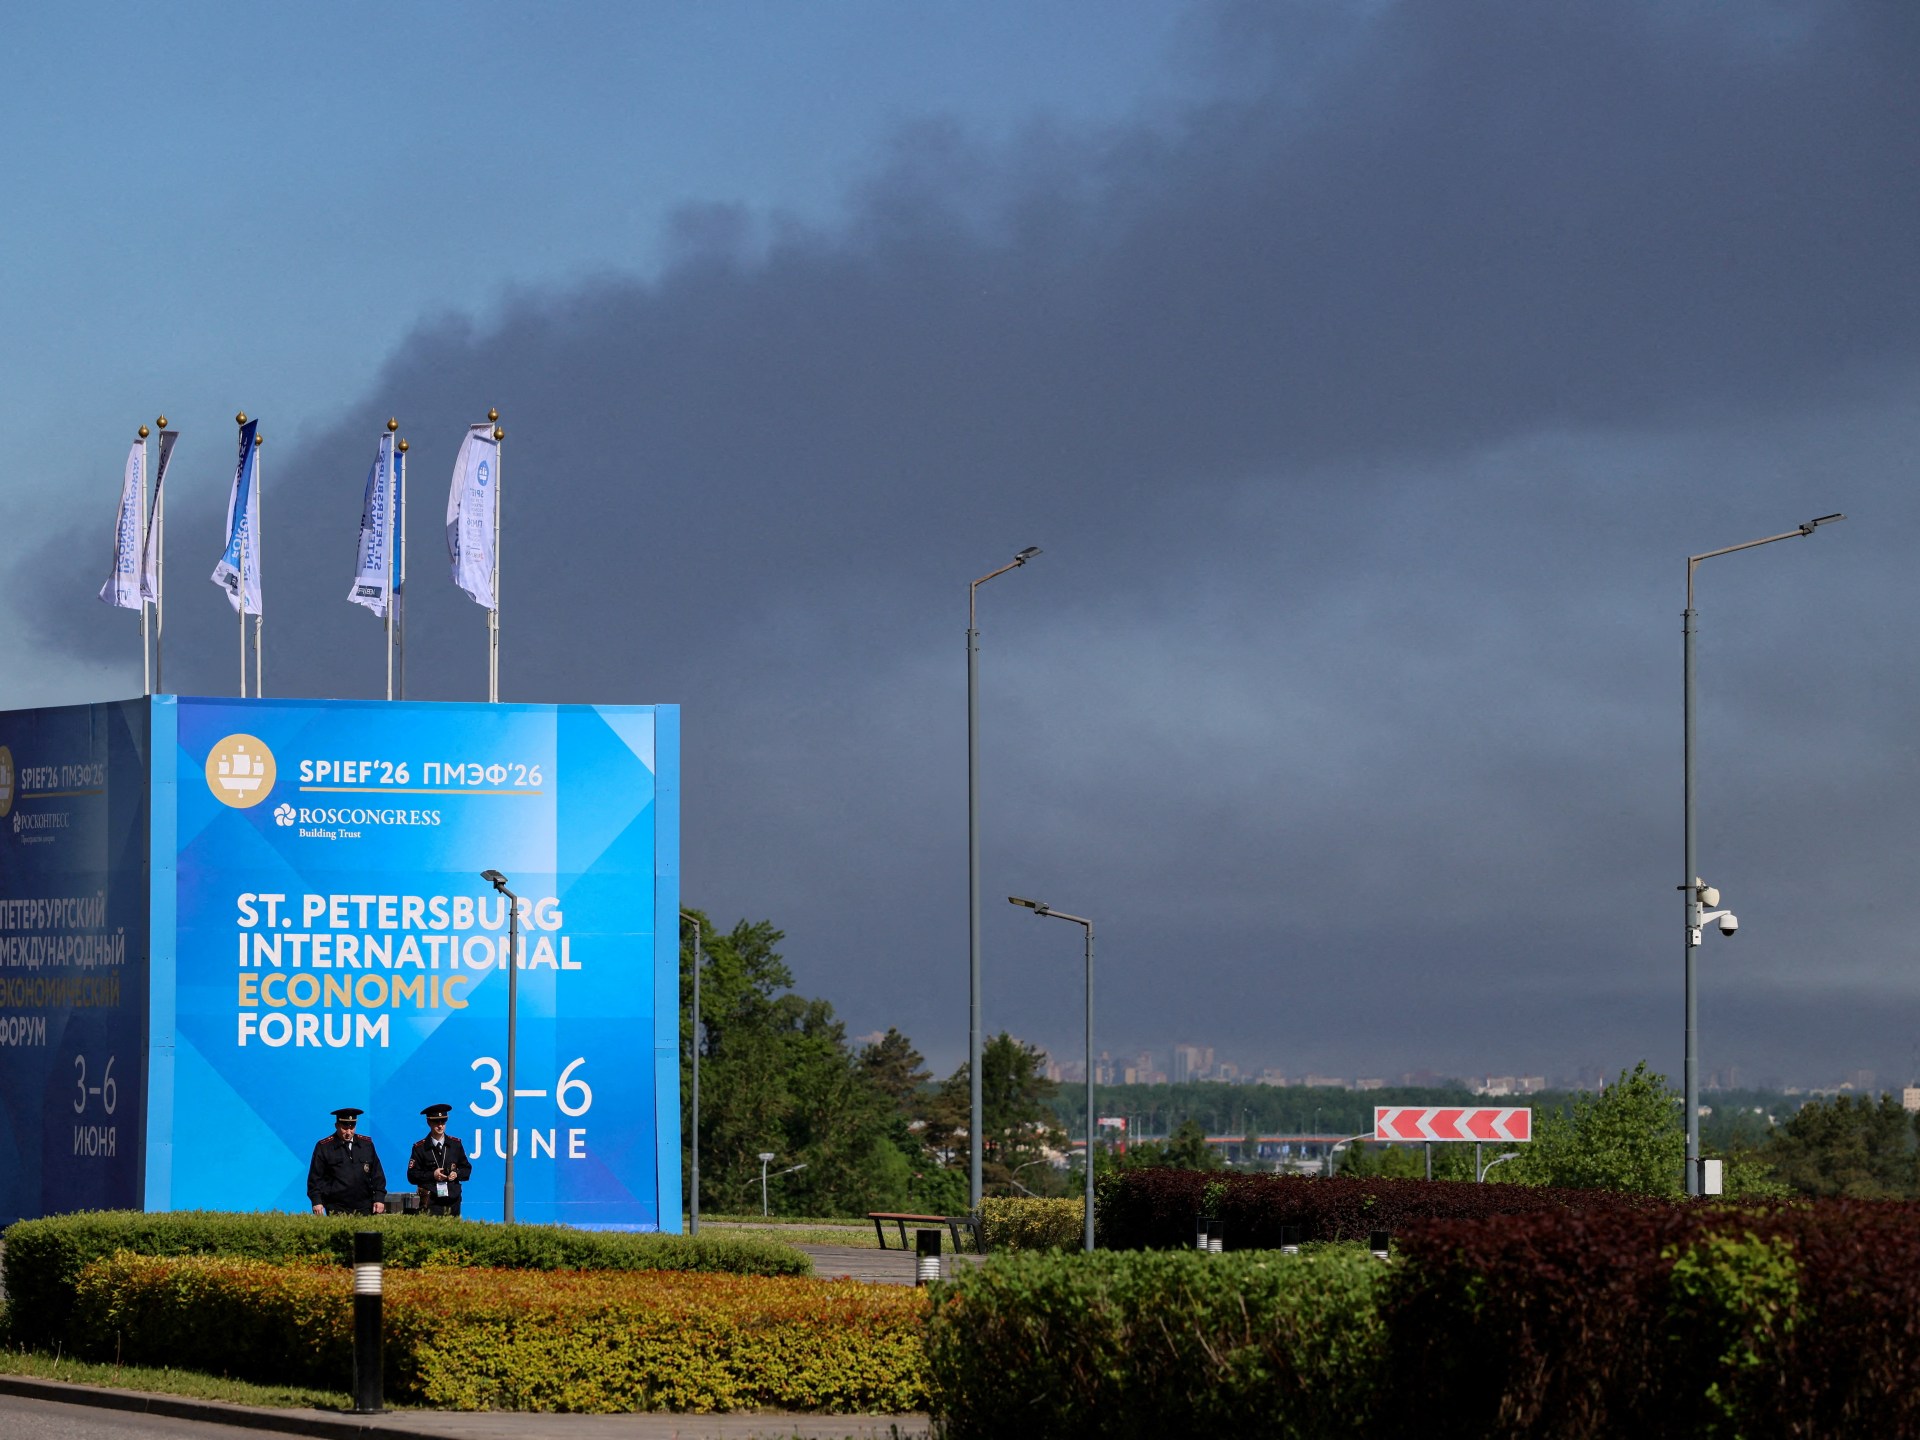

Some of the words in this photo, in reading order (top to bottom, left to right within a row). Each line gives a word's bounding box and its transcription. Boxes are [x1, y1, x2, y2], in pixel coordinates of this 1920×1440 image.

[22, 765, 58, 789] SPIEF'26
[62, 764, 104, 788] ПМЭФ'26
[299, 760, 410, 785] SPIEF'26
[423, 762, 544, 787] ПМЭФ'26
[299, 807, 441, 826] ROSCONGRESS
[299, 827, 337, 841] Building
[339, 828, 361, 839] Trust
[0, 890, 105, 929] ПЕТЕРБУРГСКИЙ
[236, 892, 291, 928] ST.
[303, 894, 563, 932] PETERSBURG
[0, 928, 125, 971] МЕЖДУНАРОДНЫЙ
[239, 932, 582, 971] INTERNATIONAL
[0, 969, 121, 1007] ЭКОНОМИЧЕСКИЙ
[238, 972, 469, 1009] ECONOMIC
[0, 1016, 46, 1047] ФОРУМ
[237, 1012, 389, 1048] FORUM
[74, 1125, 116, 1157] ИЮНЯ
[469, 1128, 587, 1160] JUNE
